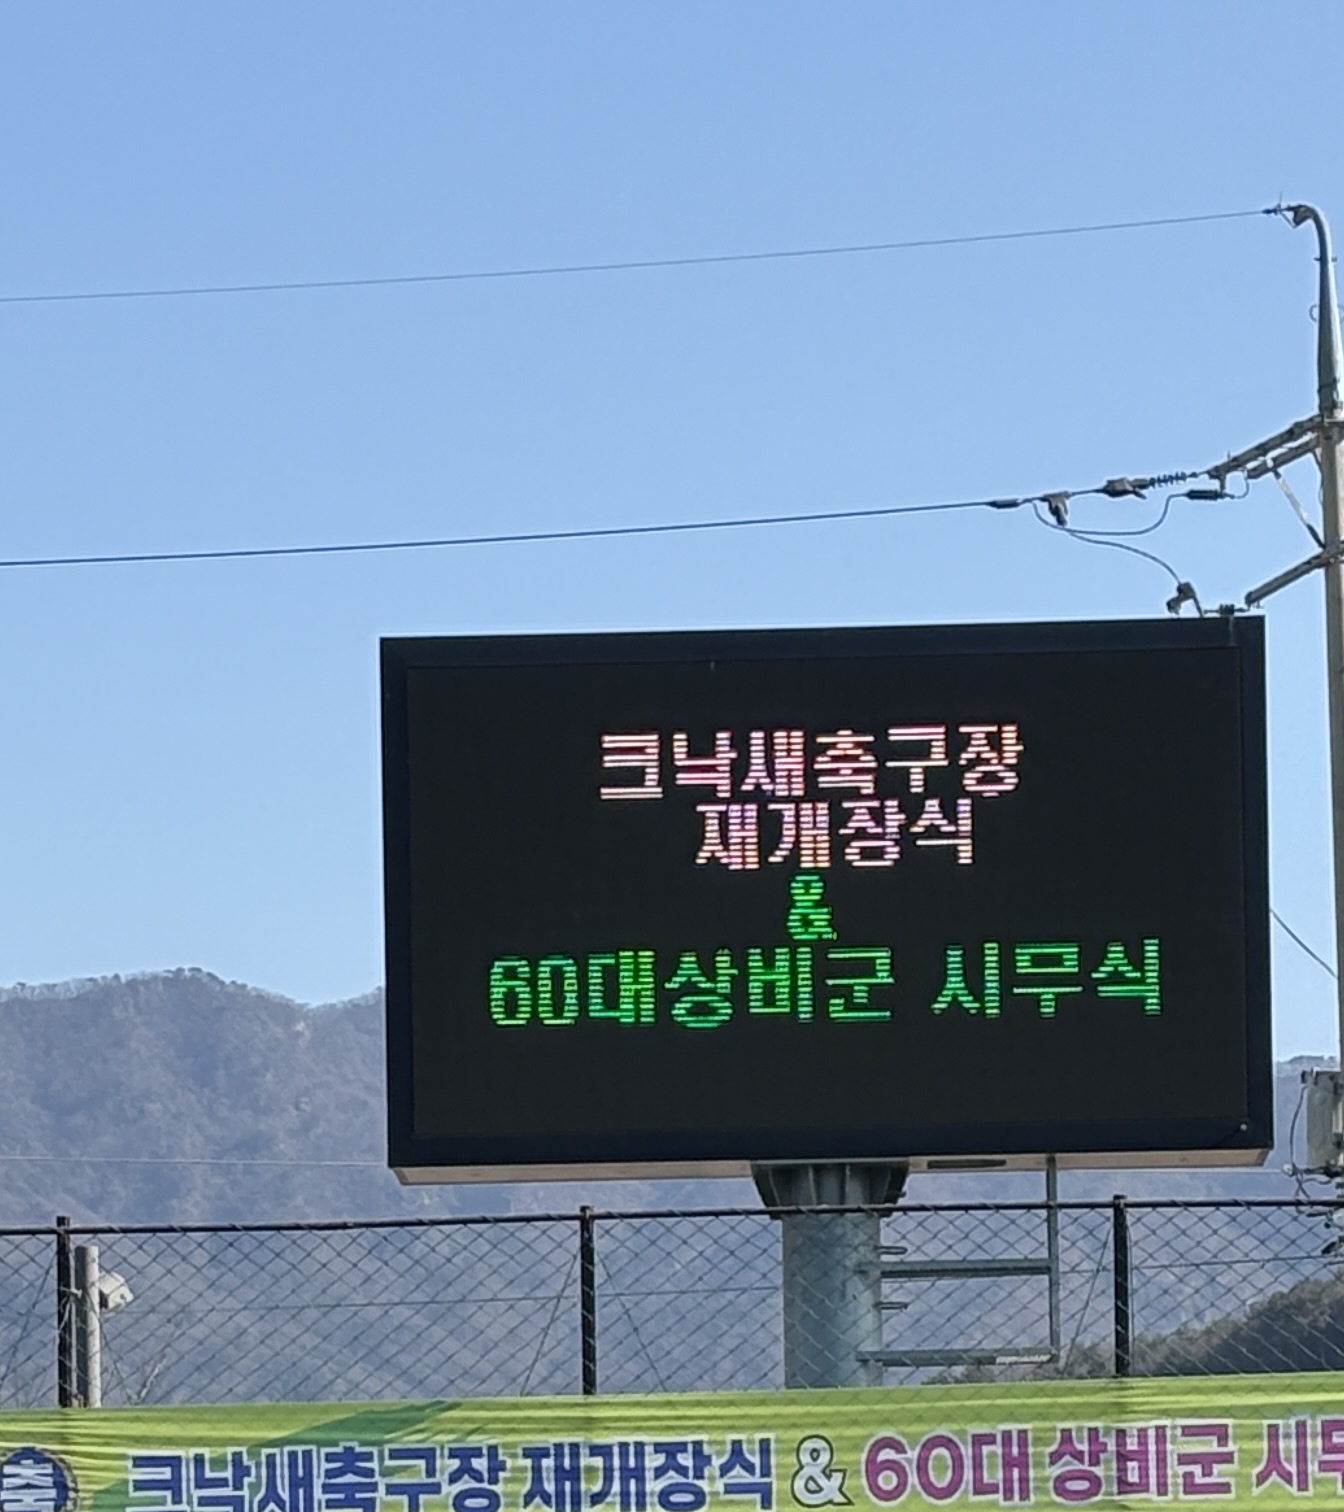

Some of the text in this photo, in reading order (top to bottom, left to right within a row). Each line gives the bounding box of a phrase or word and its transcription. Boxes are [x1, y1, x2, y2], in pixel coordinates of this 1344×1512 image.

[599, 723, 1024, 799] 크낙새축구장
[695, 799, 975, 871] 재개장식
[786, 872, 838, 942] &
[489, 938, 1163, 1029] 60대상비군 시무식
[790, 1433, 855, 1508] &
[862, 1423, 1033, 1503] 60대
[1047, 1420, 1236, 1499] 상비군
